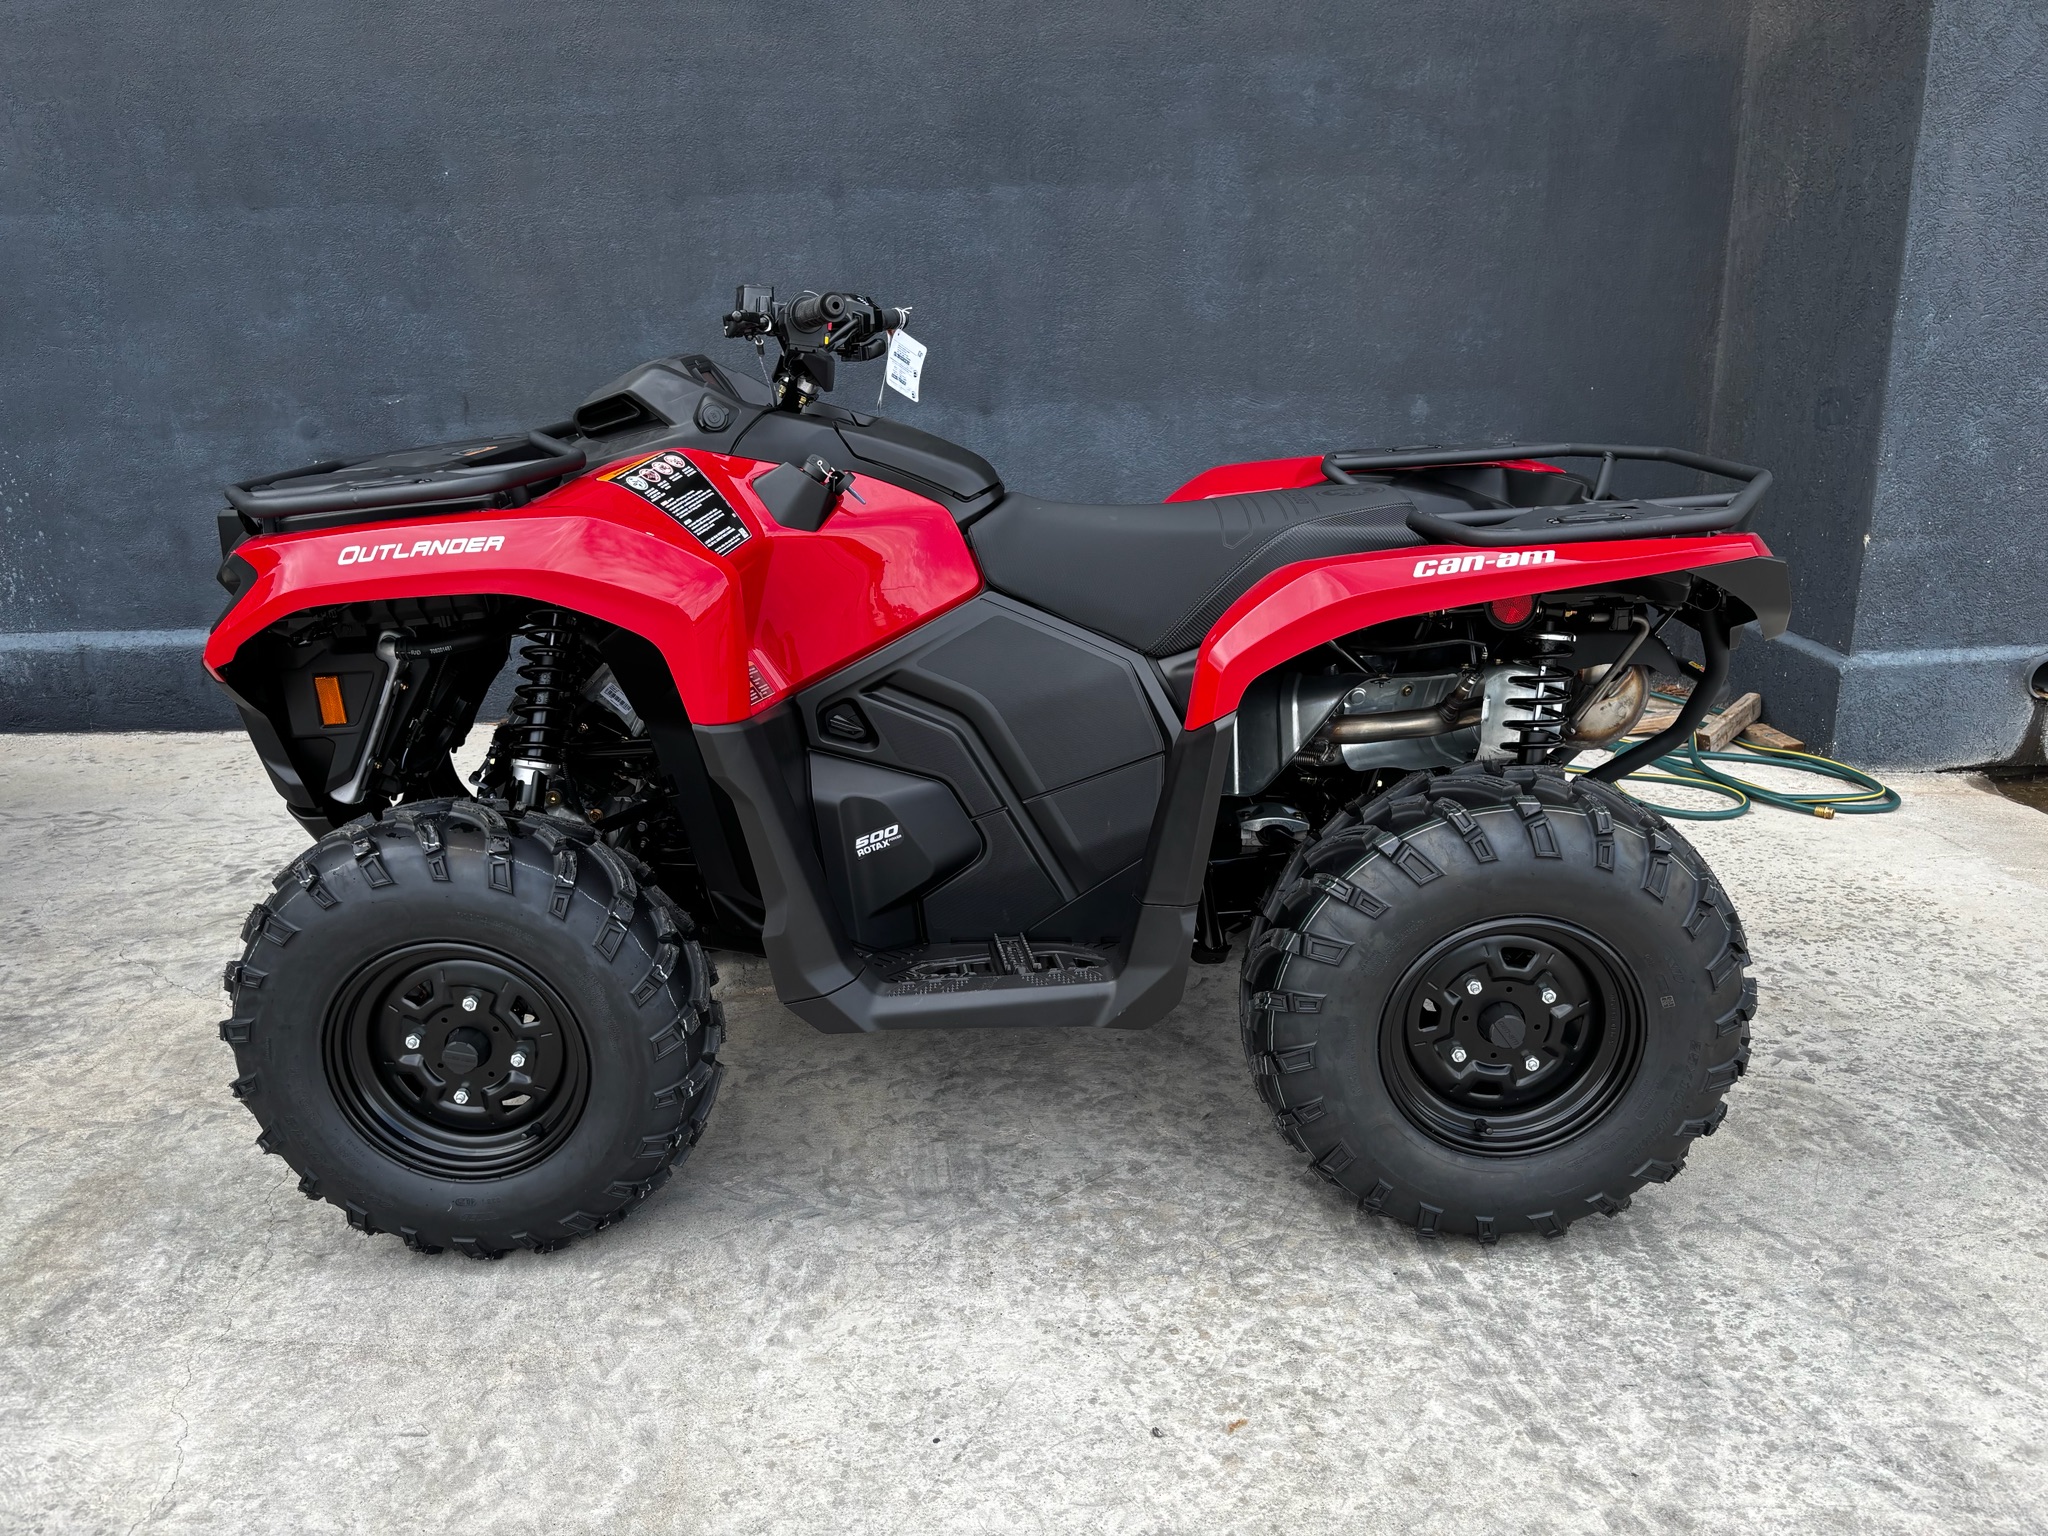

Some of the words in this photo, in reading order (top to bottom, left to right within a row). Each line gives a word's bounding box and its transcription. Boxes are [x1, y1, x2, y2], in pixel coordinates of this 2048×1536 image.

[337, 535, 505, 566] OUTLANDER
[1412, 549, 1556, 578] can-am
[855, 824, 899, 849] 500
[857, 839, 890, 857] ROTAX
